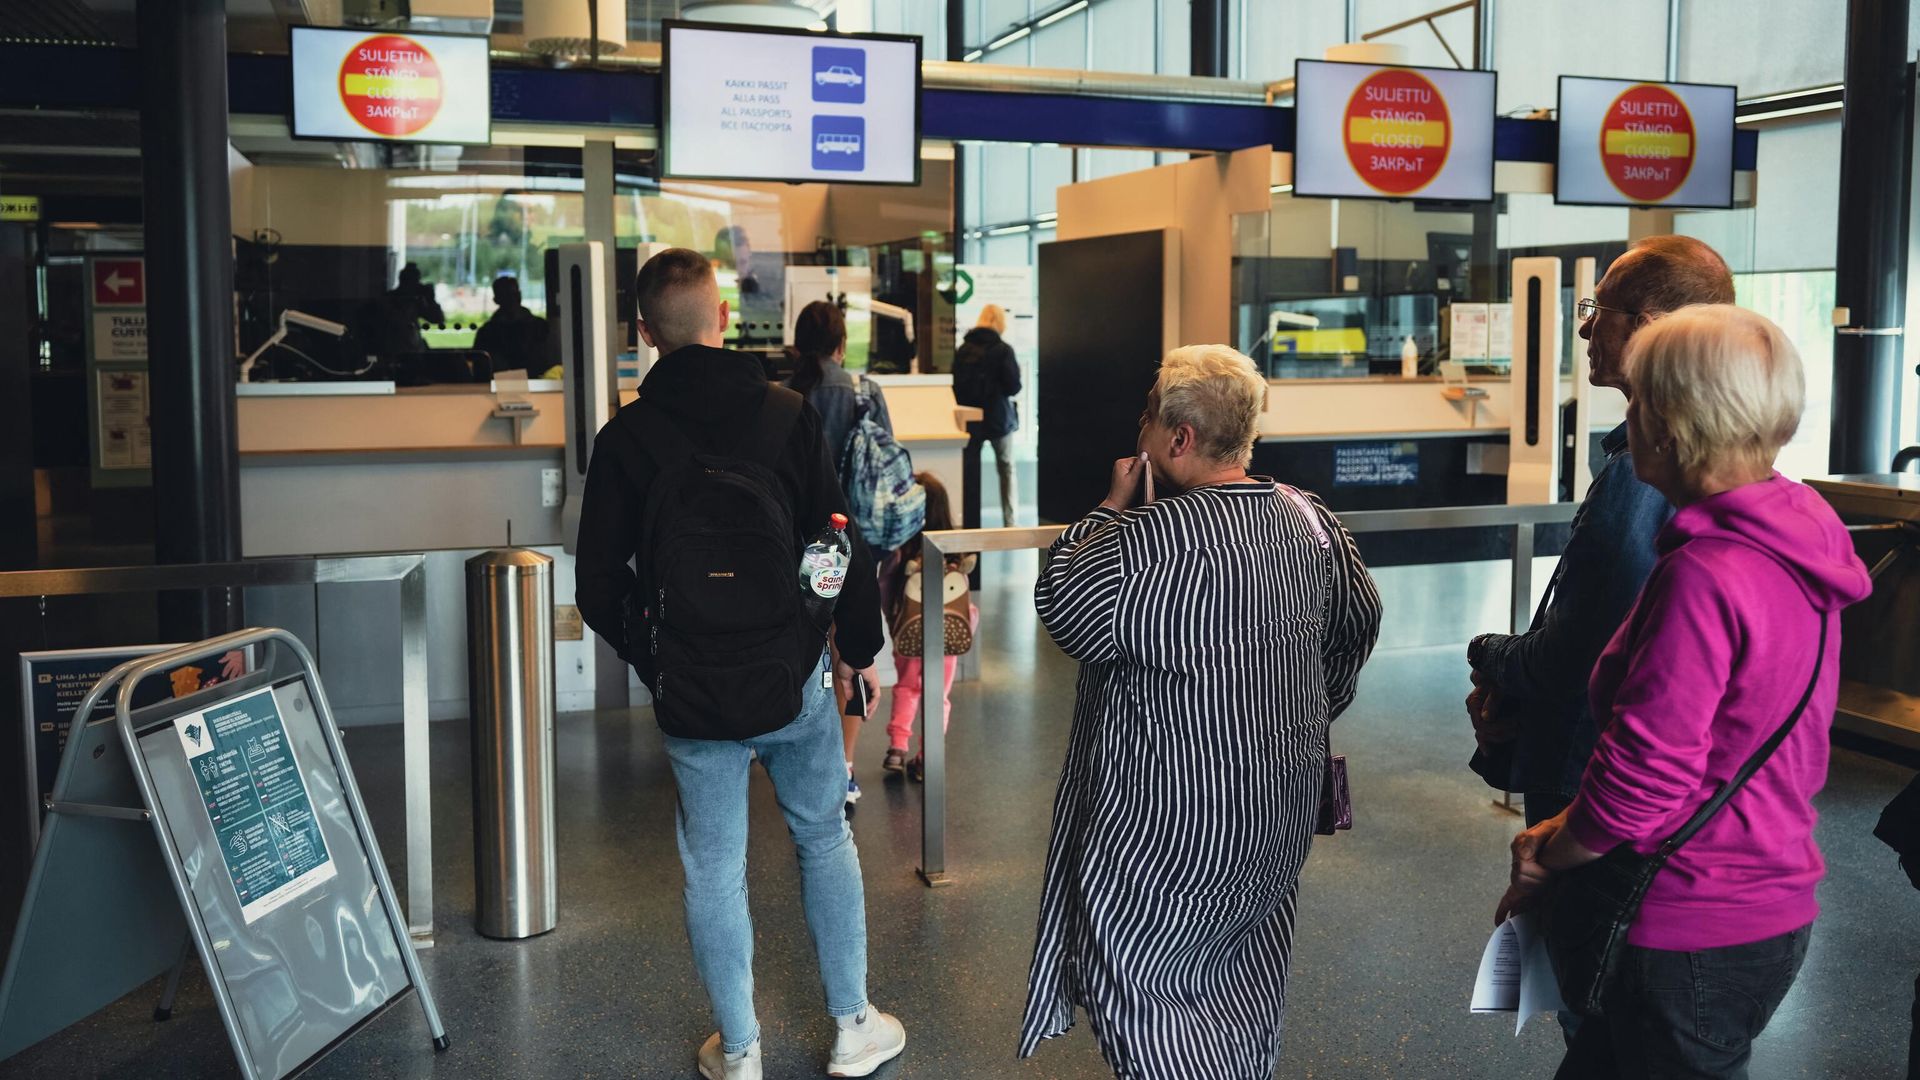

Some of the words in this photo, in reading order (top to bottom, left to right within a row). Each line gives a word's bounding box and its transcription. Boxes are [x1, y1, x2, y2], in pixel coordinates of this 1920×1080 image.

[359, 48, 424, 63] SULJETTU
[364, 66, 419, 81] STÄNGD
[725, 79, 756, 89] KAIKKI
[758, 81, 788, 90] PASSIT
[367, 86, 417, 100] CLOSED
[733, 94, 756, 103] ALLA
[758, 95, 780, 104] PASS
[1365, 86, 1431, 103] SULJETTU
[721, 107, 737, 117] ALL
[740, 108, 792, 118] PASSPORTS
[1370, 108, 1426, 125] STÄNGD
[1620, 101, 1678, 117] SULJETTU
[721, 121, 738, 130] ВСЕ
[741, 121, 792, 132] ПАСПОРТА
[1624, 120, 1673, 136] STÄNGD
[1371, 132, 1424, 149] CLOSED
[1625, 145, 1671, 160] CLOSED
[112, 316, 145, 326] TULLI
